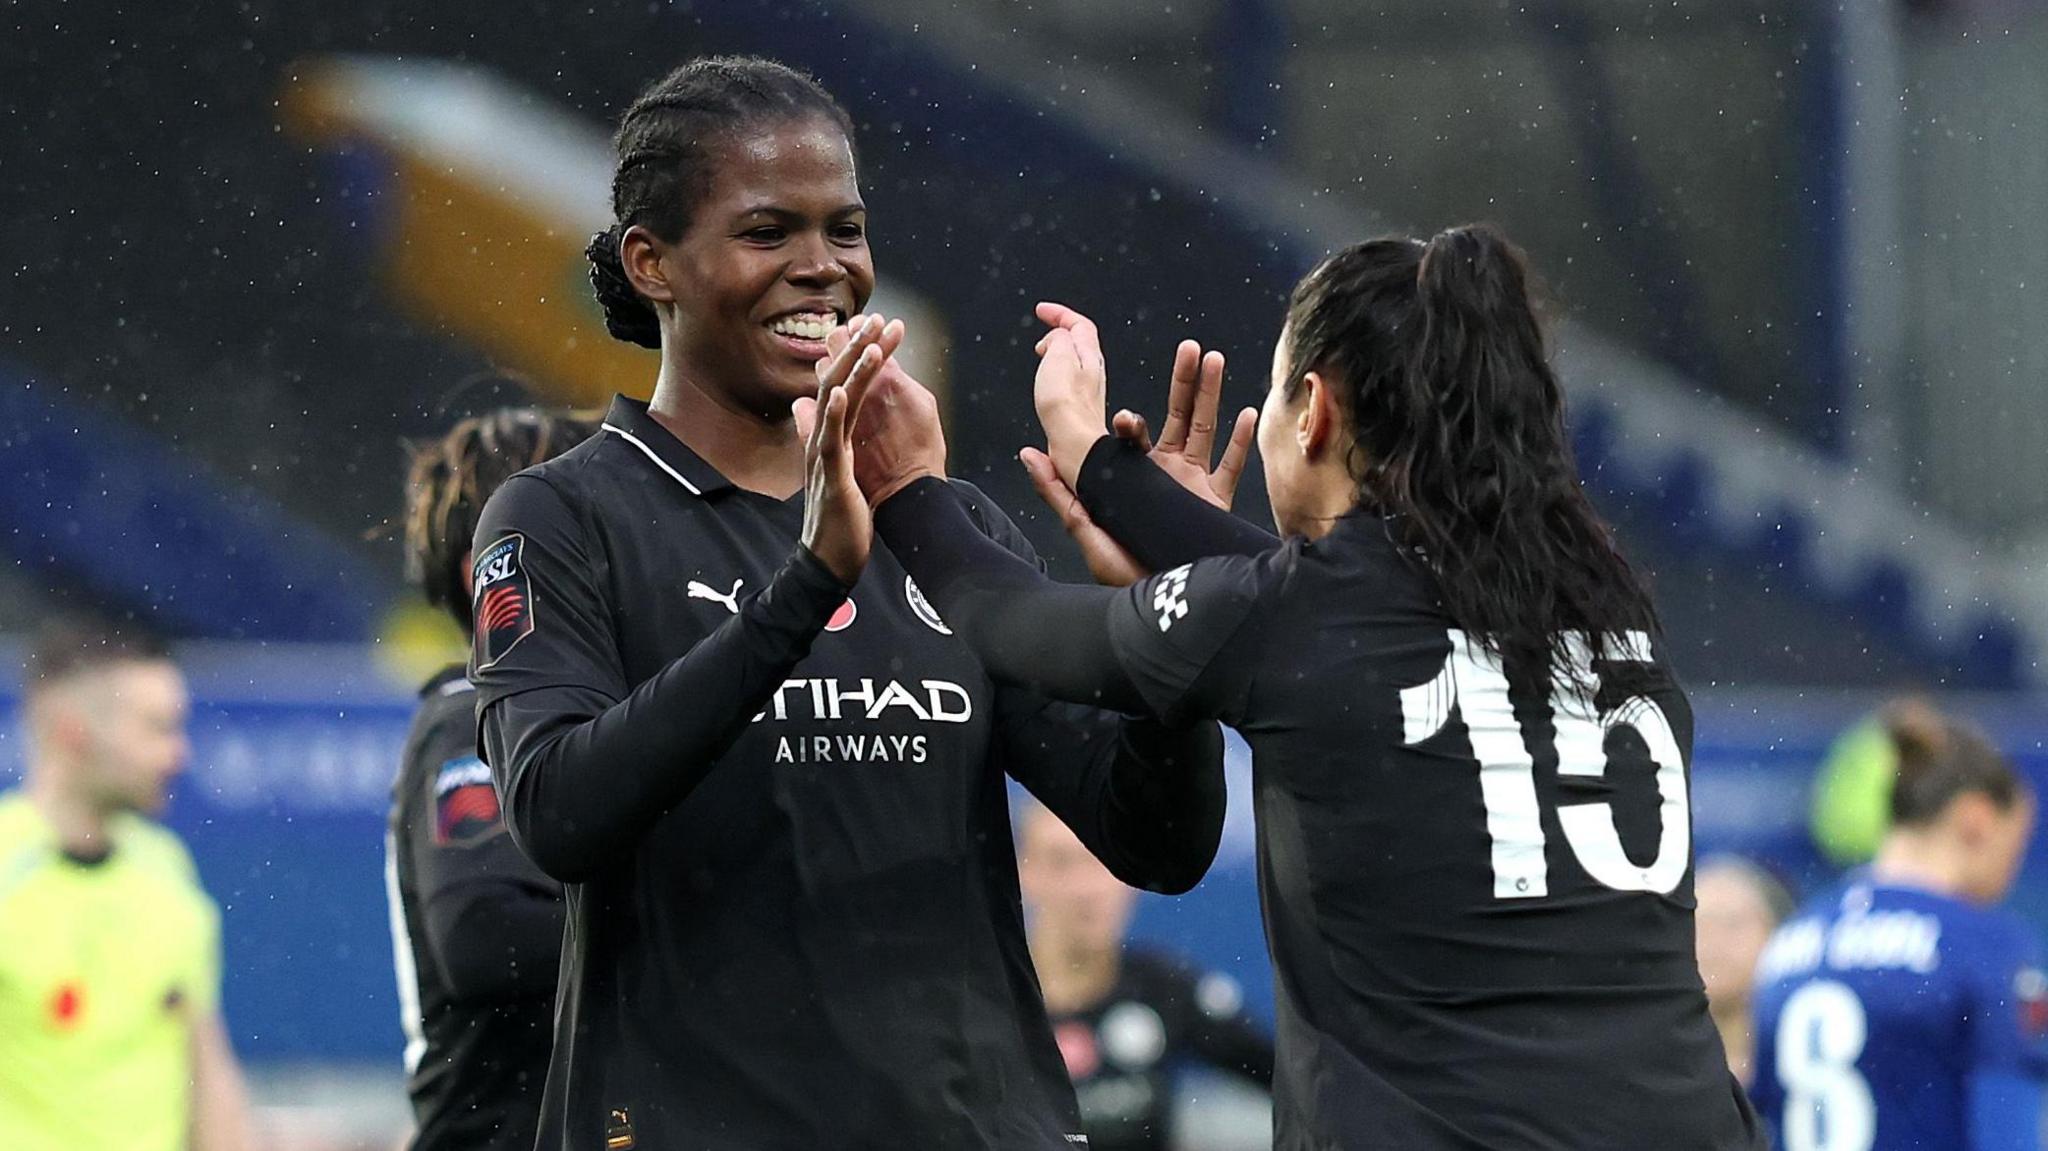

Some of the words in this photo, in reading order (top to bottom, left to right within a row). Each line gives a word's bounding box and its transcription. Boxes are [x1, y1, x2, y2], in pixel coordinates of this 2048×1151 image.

[752, 678, 972, 722] TIHAD
[775, 735, 927, 763] AIRWAYS
[1400, 628, 1690, 898] 15
[1775, 978, 1877, 1151] 8
